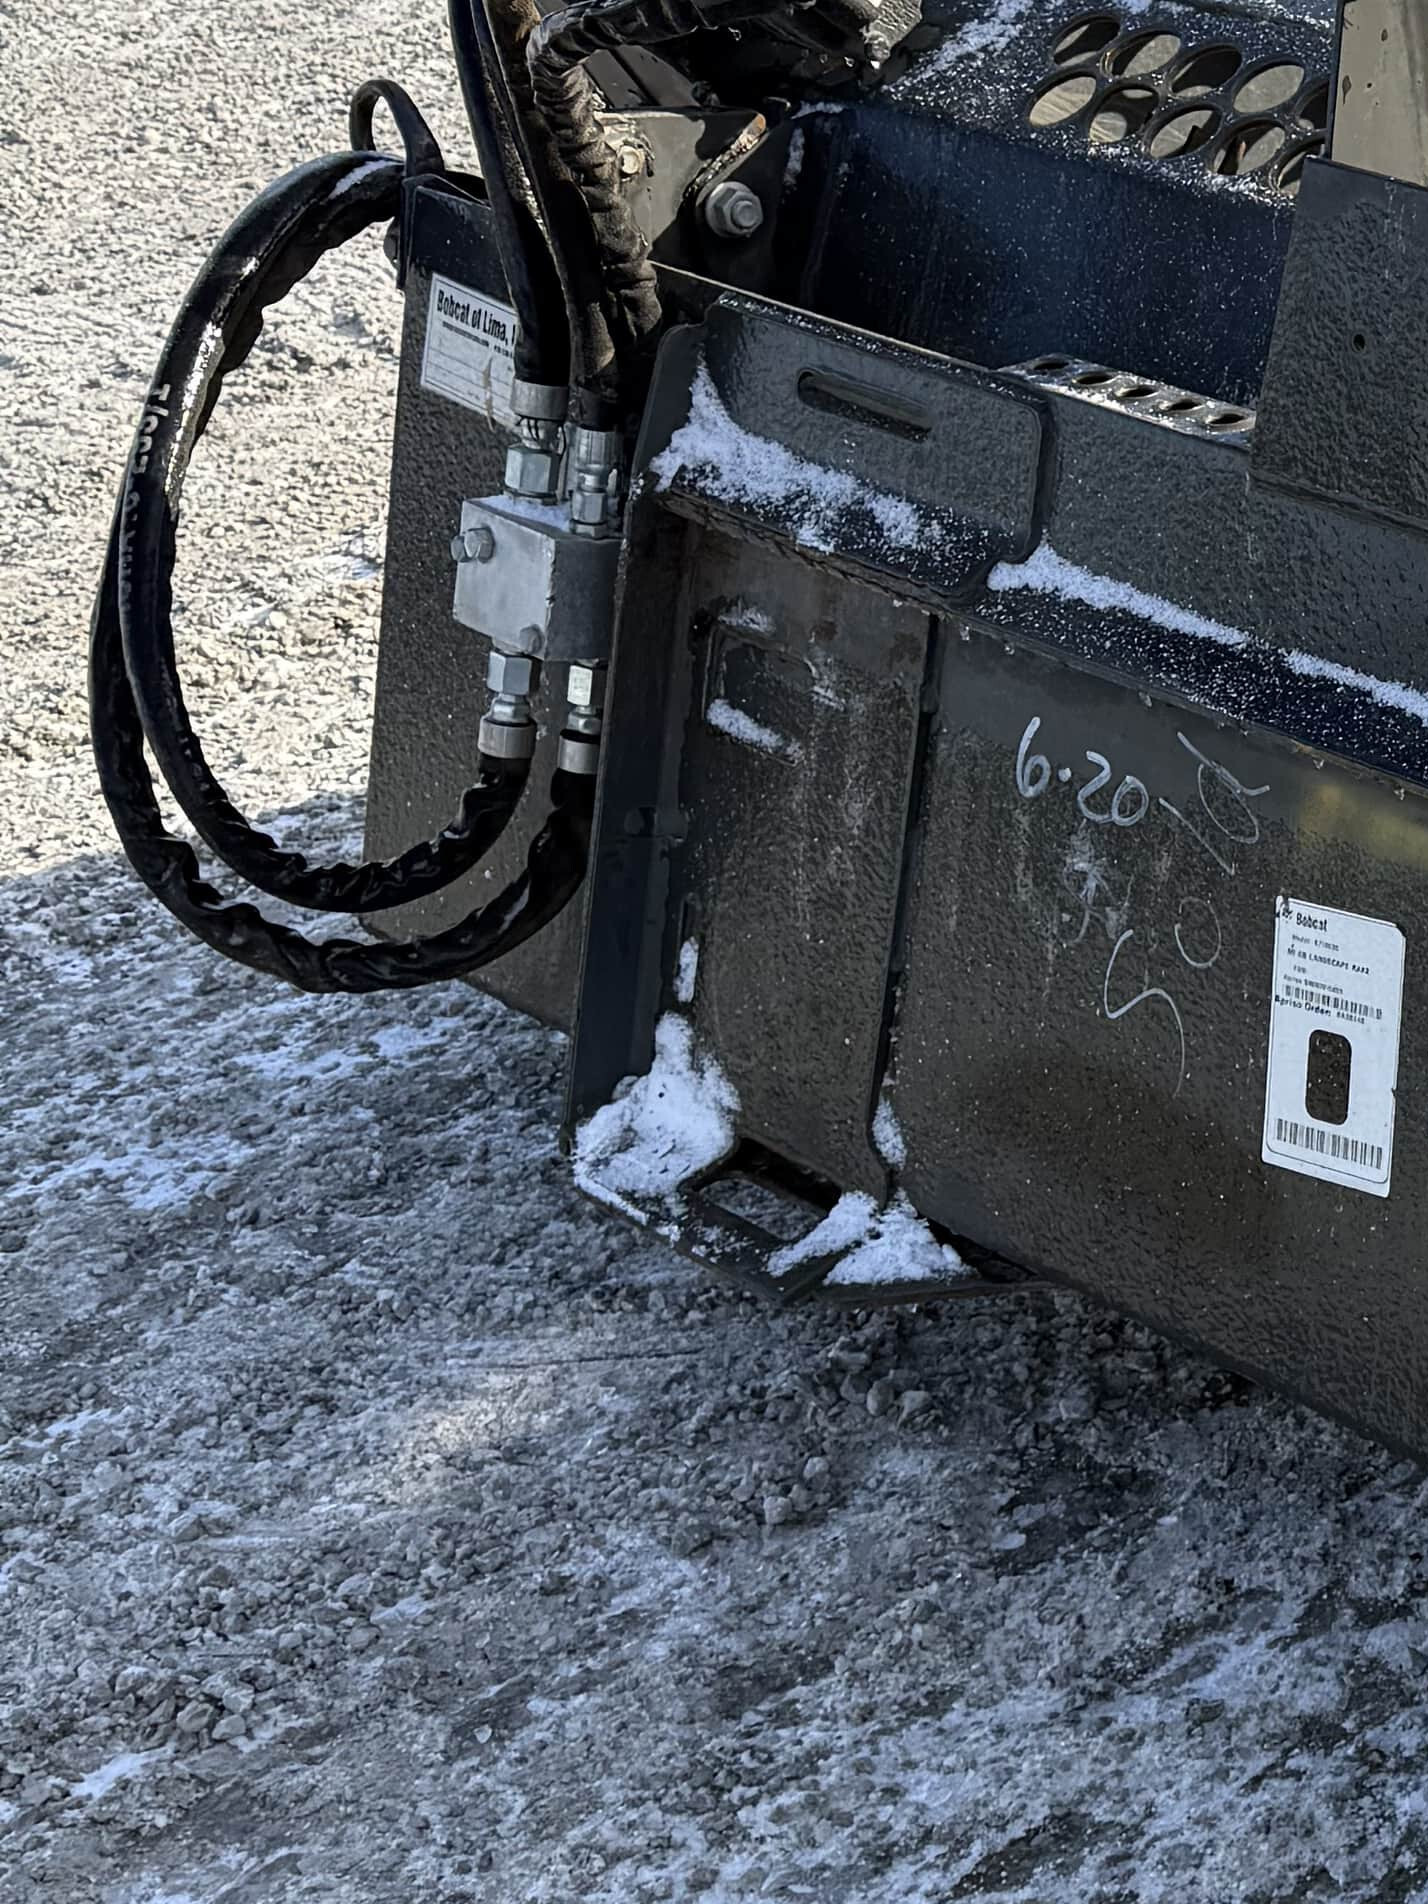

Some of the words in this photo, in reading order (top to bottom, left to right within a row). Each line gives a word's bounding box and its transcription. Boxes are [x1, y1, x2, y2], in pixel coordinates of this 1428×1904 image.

[437, 289, 470, 325] Bobcat
[471, 308, 482, 329] of
[483, 310, 509, 345] Lima,
[1295, 912, 1327, 932] Bobcat
